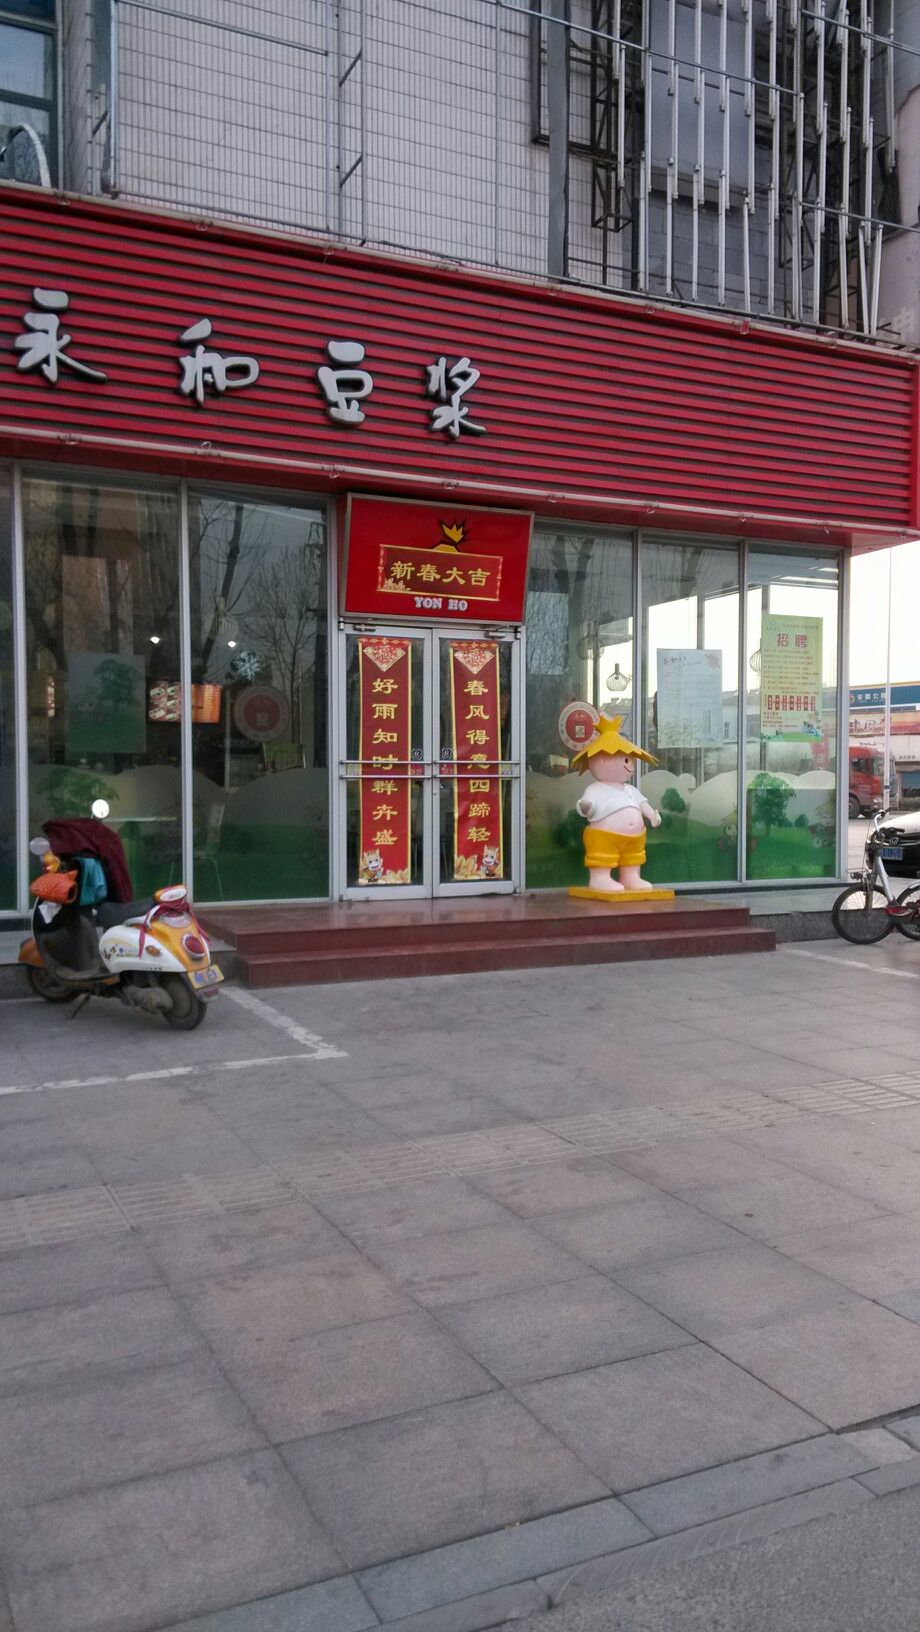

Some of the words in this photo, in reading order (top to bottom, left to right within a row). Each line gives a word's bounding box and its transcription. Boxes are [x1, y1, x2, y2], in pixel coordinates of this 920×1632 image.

[14, 287, 487, 440] 永和豆浆
[390, 560, 491, 587] 新春大吉
[413, 596, 442, 609] YON
[447, 598, 469, 612] HO
[776, 633, 808, 648] 招聘
[372, 679, 399, 846] 好雨知时群卉盛
[464, 680, 491, 842] 春风得意四蹄轻
